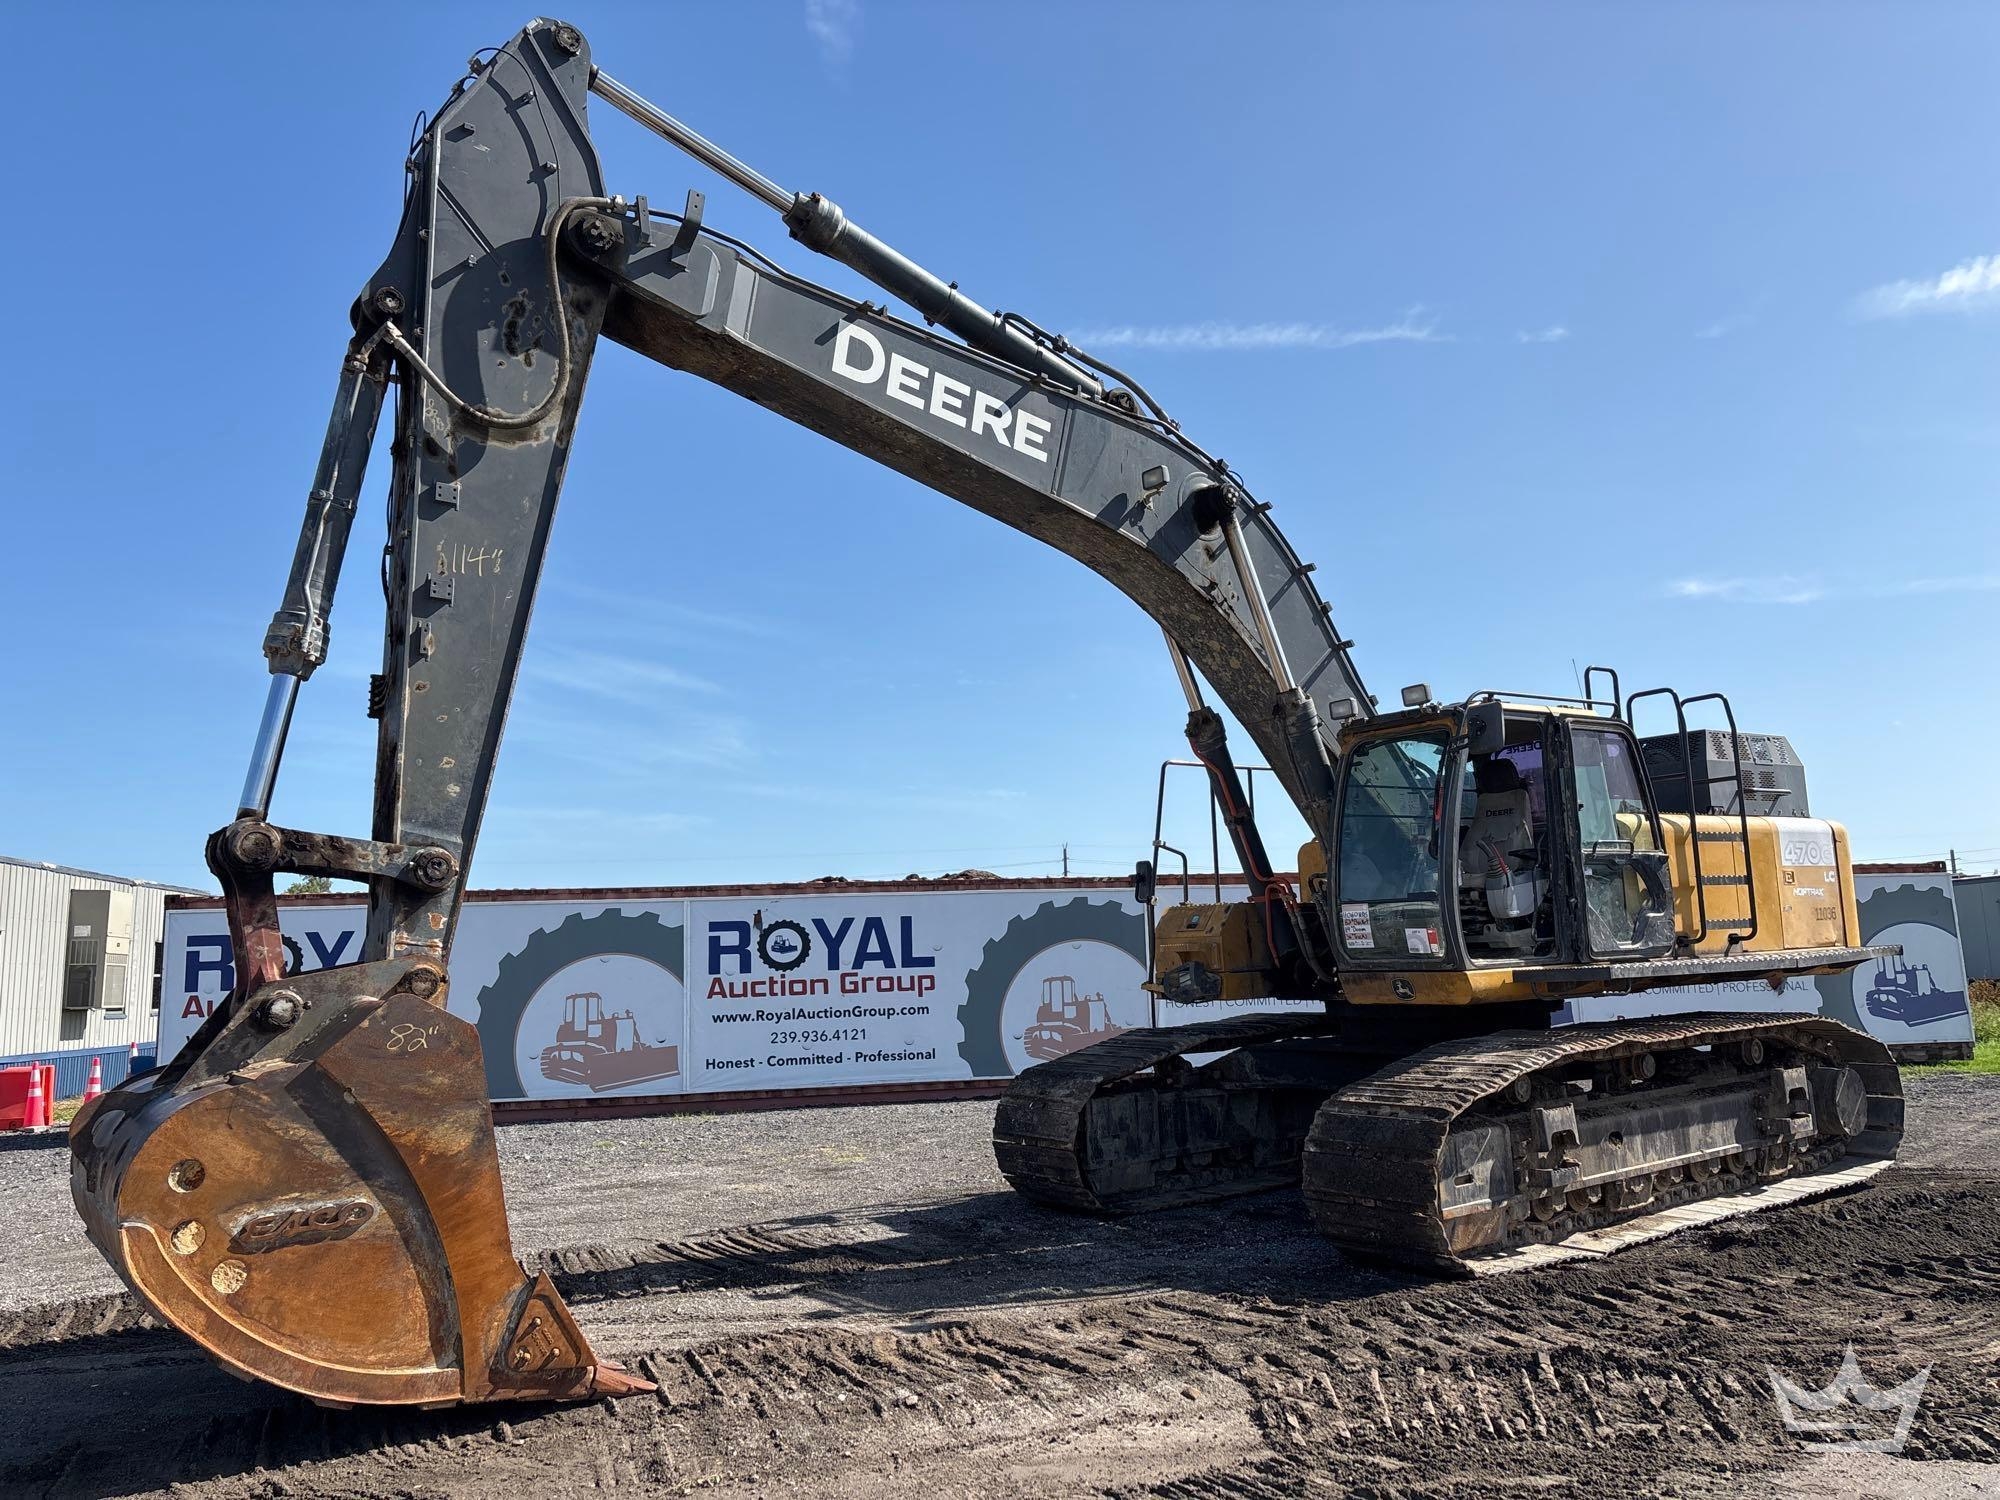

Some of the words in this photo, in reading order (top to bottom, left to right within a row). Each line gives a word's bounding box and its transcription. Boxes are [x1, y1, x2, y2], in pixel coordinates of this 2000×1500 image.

[832, 319, 1051, 463] DEERE
[1485, 808, 1514, 817] DEERE
[1824, 871, 1836, 883] LC
[708, 916, 936, 975] ROYAL
[707, 974, 829, 999] Auction
[840, 972, 935, 997] Group
[1722, 980, 1809, 993] PROFESSNAL
[711, 1004, 930, 1024] www.RoyalAuctionGroup.com
[386, 1023, 440, 1052] 82"
[770, 1028, 867, 1045] 239.936.4121
[705, 1057, 756, 1070] Honest
[766, 1052, 843, 1068] Committed
[854, 1048, 937, 1063] Professional
